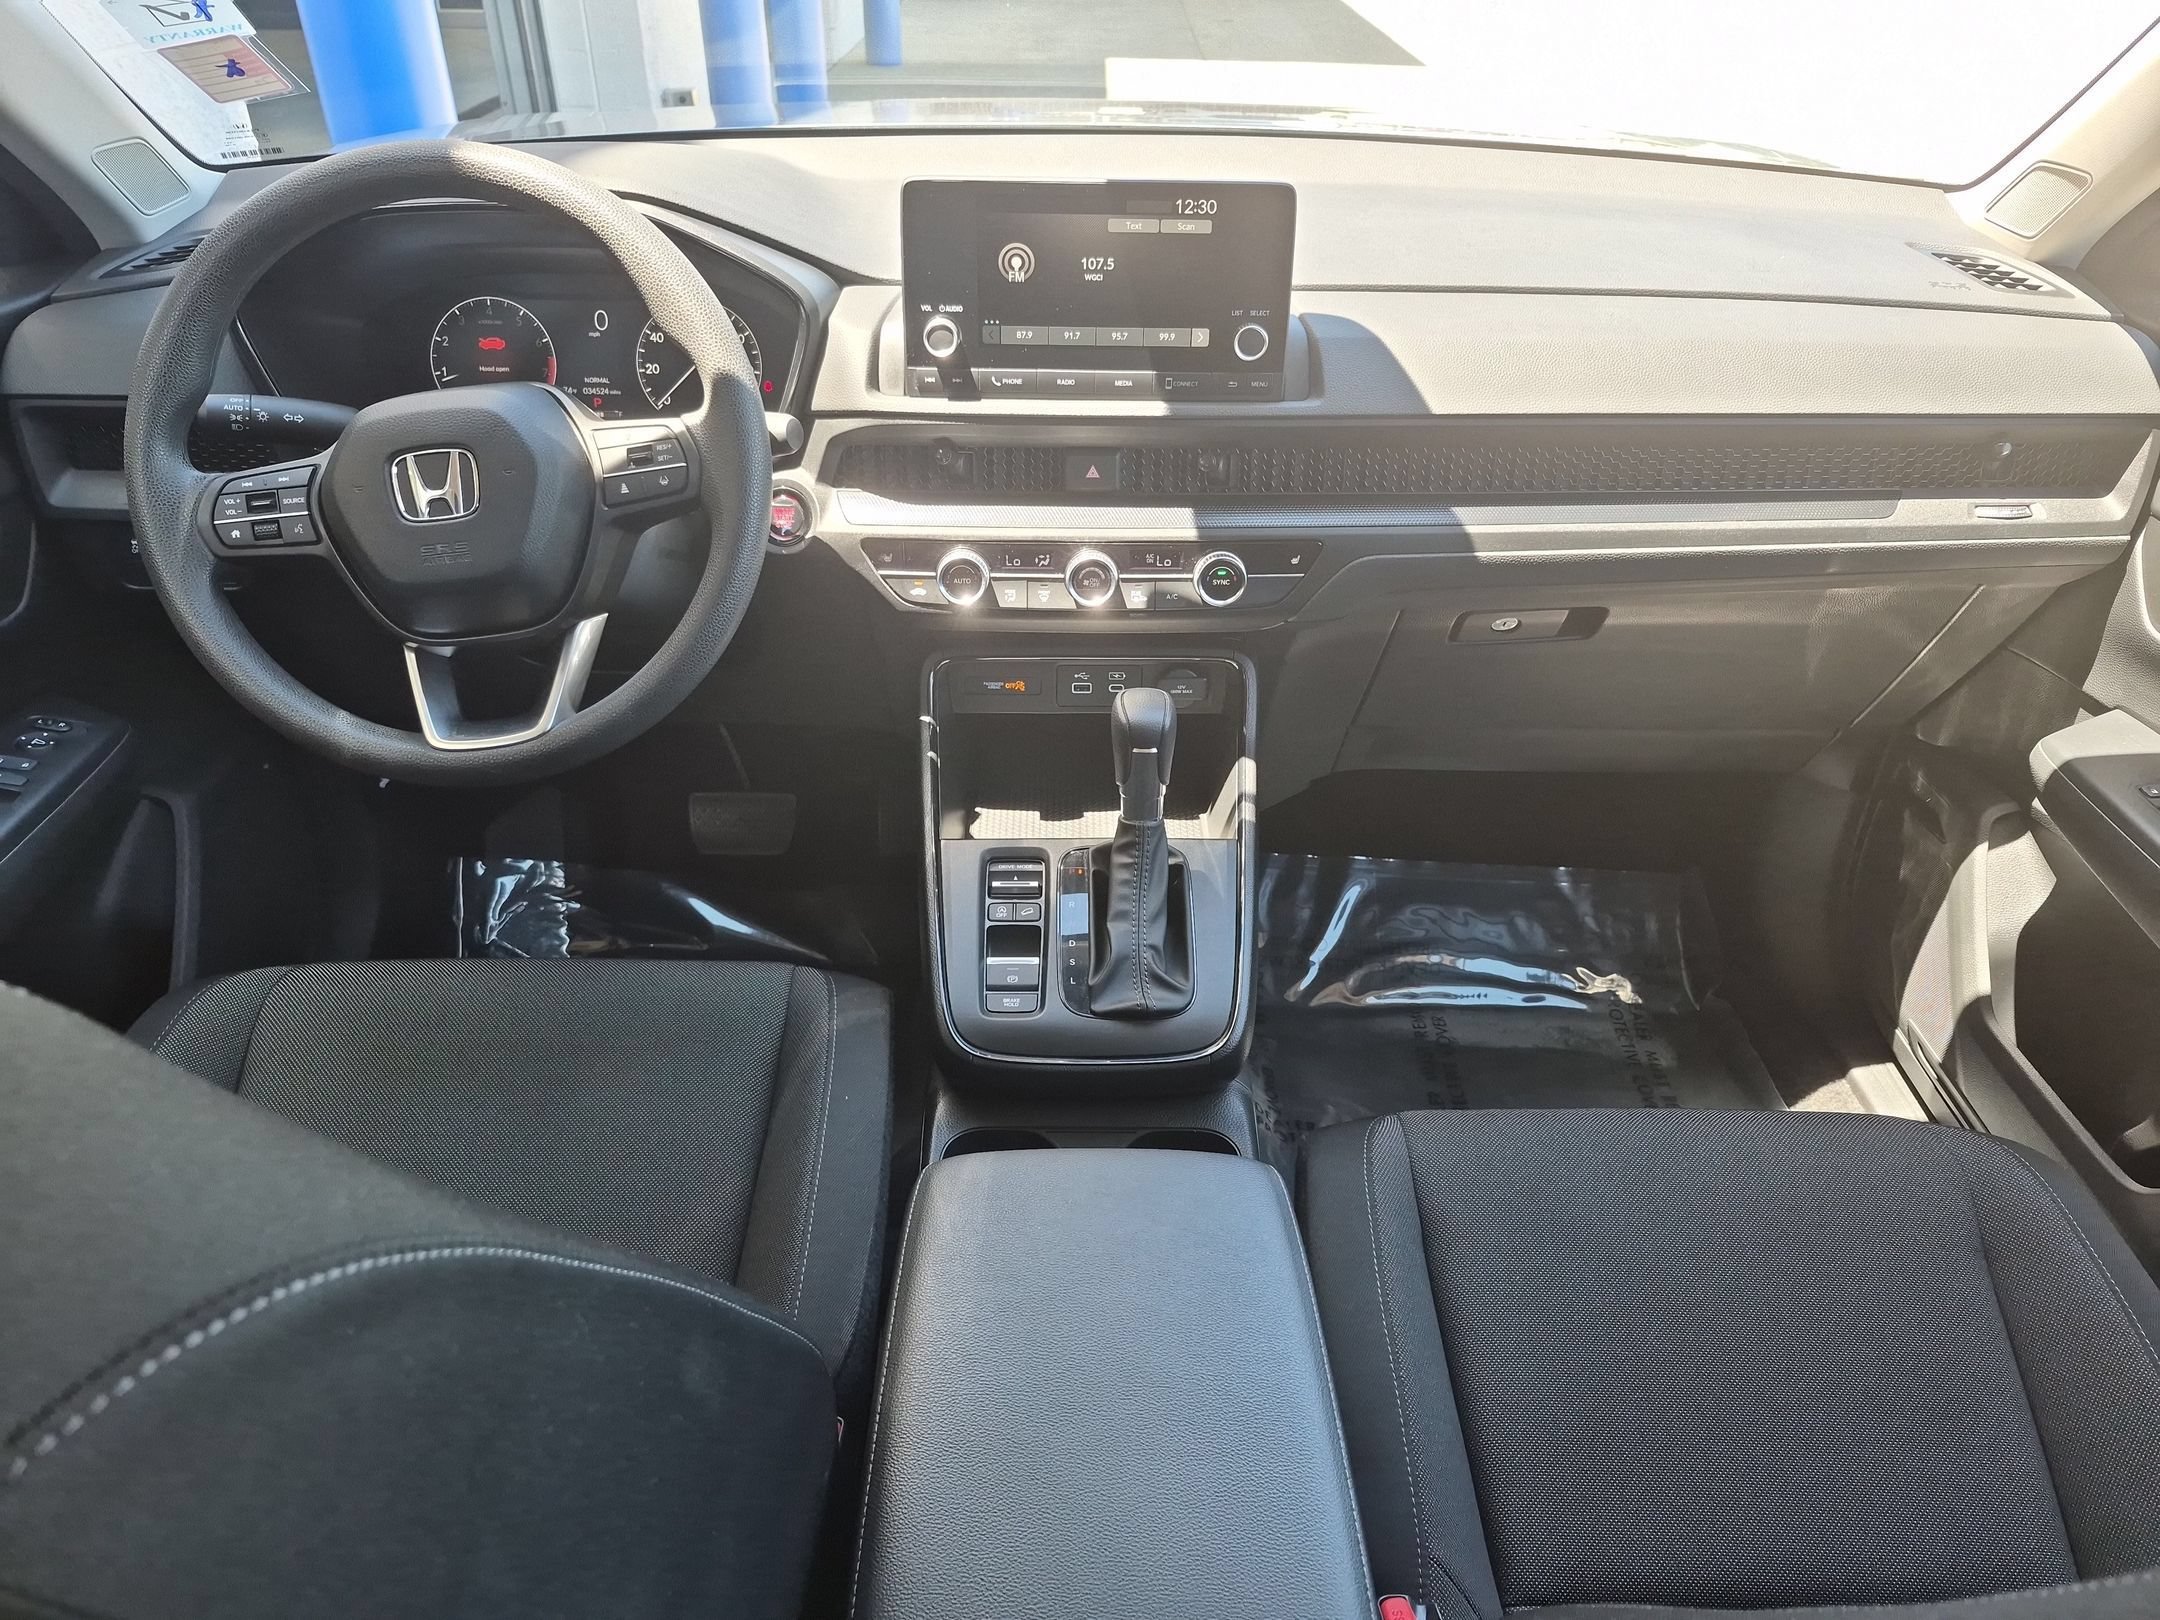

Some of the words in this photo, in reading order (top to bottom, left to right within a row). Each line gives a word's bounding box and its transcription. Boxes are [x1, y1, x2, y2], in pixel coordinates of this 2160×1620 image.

[1175, 199, 1218, 215] 12:30
[1125, 222, 1143, 230] Text
[1177, 222, 1196, 231] Scan
[1081, 257, 1115, 270] 107.5
[1008, 271, 1025, 283] FM
[920, 304, 933, 312] VOL
[594, 309, 609, 331] 0
[649, 332, 665, 343] 40
[1016, 331, 1033, 339] 87.9
[1064, 332, 1080, 340] 91.7
[1111, 332, 1129, 341] 95.7
[1159, 333, 1176, 341] 99.9
[442, 336, 449, 347] 2
[442, 366, 447, 377] 1
[645, 363, 660, 375] 20
[1056, 378, 1076, 386] RADIO
[582, 387, 610, 395] 034524
[593, 398, 602, 408] P
[282, 497, 305, 505] SOURCE
[1005, 555, 1021, 566] Lo
[1156, 555, 1172, 567] Lo
[1068, 901, 1076, 909] R
[1068, 939, 1076, 947] D
[1069, 958, 1076, 966] S
[1070, 977, 1076, 985] L
